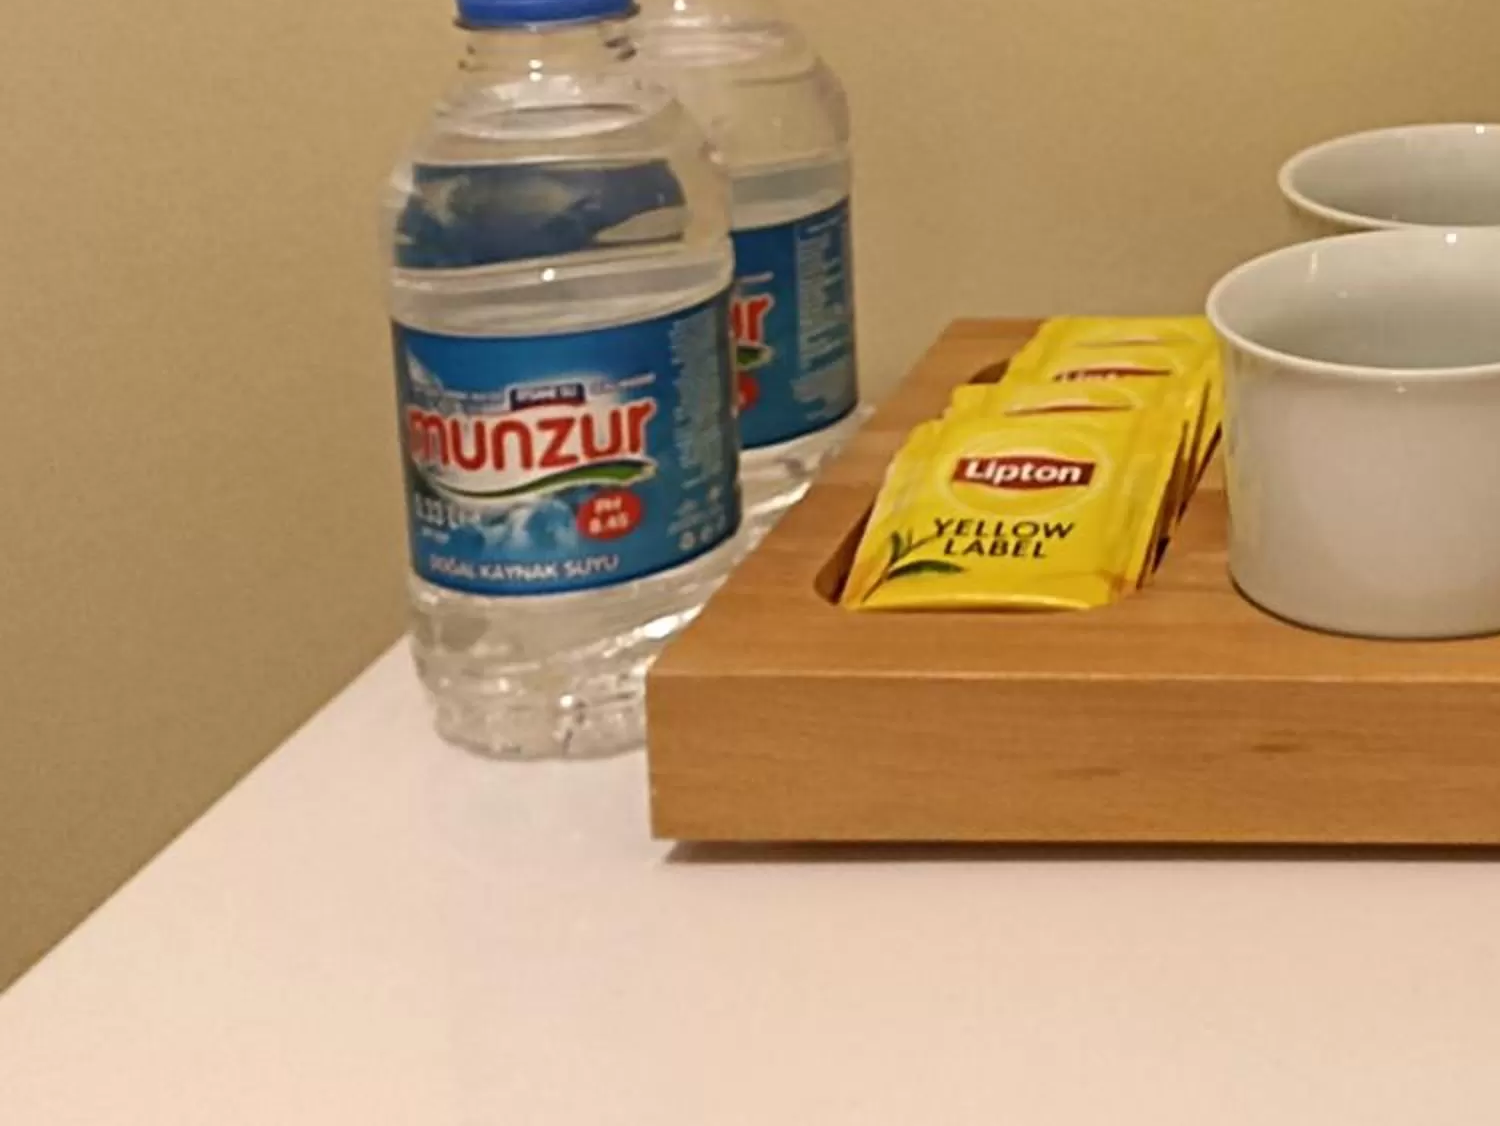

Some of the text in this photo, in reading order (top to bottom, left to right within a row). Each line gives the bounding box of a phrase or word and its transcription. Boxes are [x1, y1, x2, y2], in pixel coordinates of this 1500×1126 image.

[407, 400, 656, 473] munzur
[964, 459, 1084, 485] Lipton
[933, 517, 1075, 540] YELLOW
[943, 539, 1047, 559] LABEL
